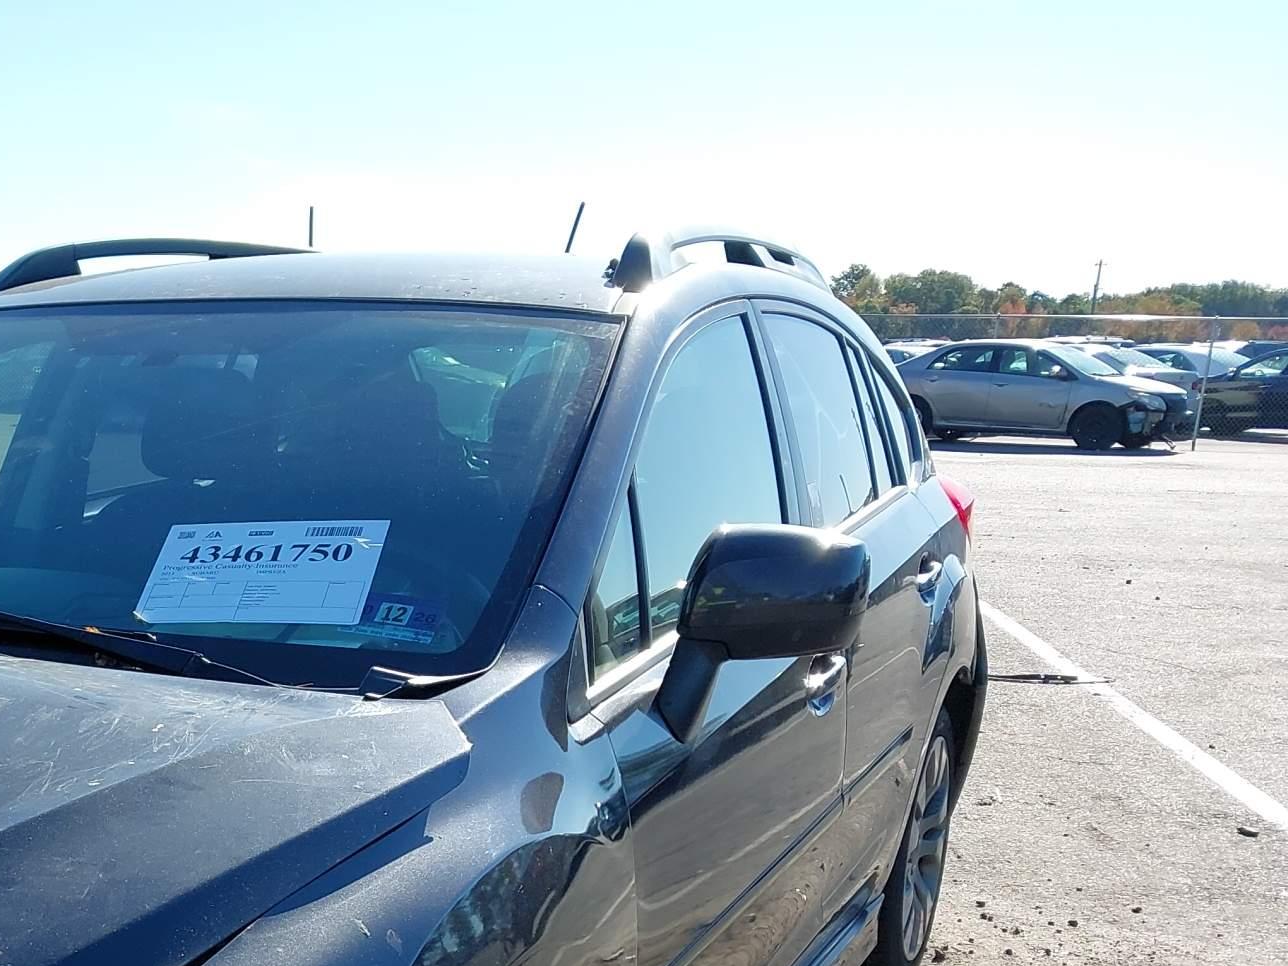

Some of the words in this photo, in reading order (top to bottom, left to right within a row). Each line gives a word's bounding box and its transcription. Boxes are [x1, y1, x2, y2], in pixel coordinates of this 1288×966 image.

[179, 543, 353, 563] 43461750
[163, 563, 213, 572] Progressive
[215, 562, 252, 570] Casualty
[255, 561, 299, 569] Insurance
[381, 604, 408, 622] 12
